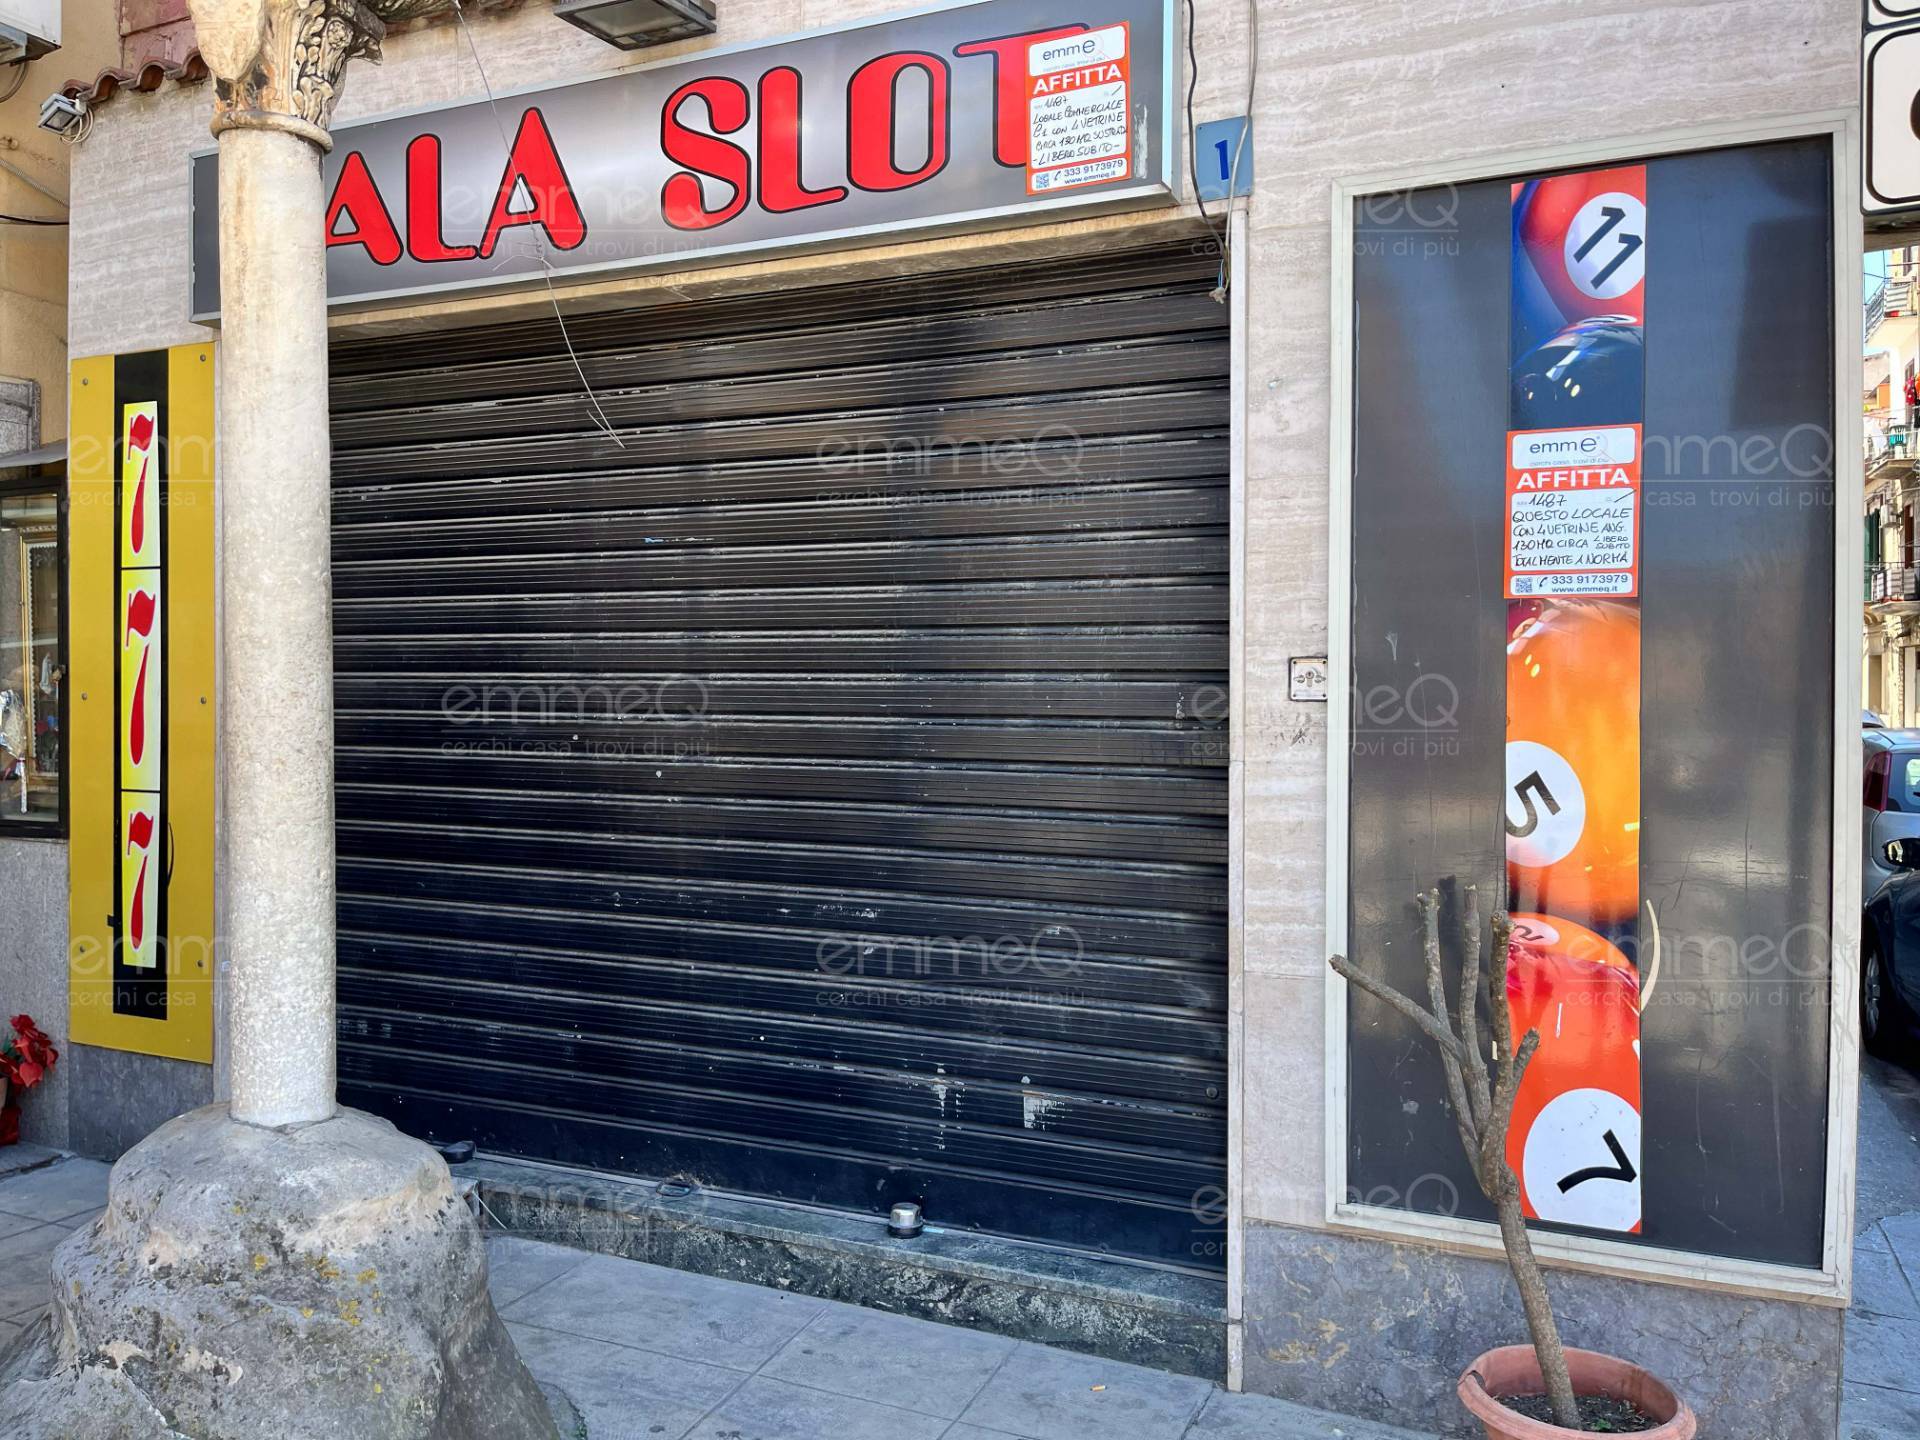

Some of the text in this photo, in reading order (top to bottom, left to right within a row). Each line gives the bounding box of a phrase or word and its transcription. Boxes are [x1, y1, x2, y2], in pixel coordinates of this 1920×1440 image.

[1033, 64, 1122, 95] AFFITTA
[325, 24, 1089, 266] ALA SLOT
[1215, 140, 1229, 180] 1
[1064, 160, 1123, 177] 333 9173979
[1573, 206, 1642, 290] 11
[126, 412, 155, 555] 7
[1516, 468, 1630, 489] AFFITTA
[1512, 508, 1632, 523] QUESTO LOCALE
[1528, 493, 1567, 507] 1487
[1513, 525, 1534, 537] CON
[1557, 539, 1588, 548] CIRCA
[1552, 575, 1628, 584] 333 9173979
[1552, 585, 1618, 593] www.emmeq.it
[125, 589, 156, 766] 7
[1506, 770, 1561, 837] 5
[126, 810, 154, 953] 7
[1557, 1129, 1637, 1194] 7
